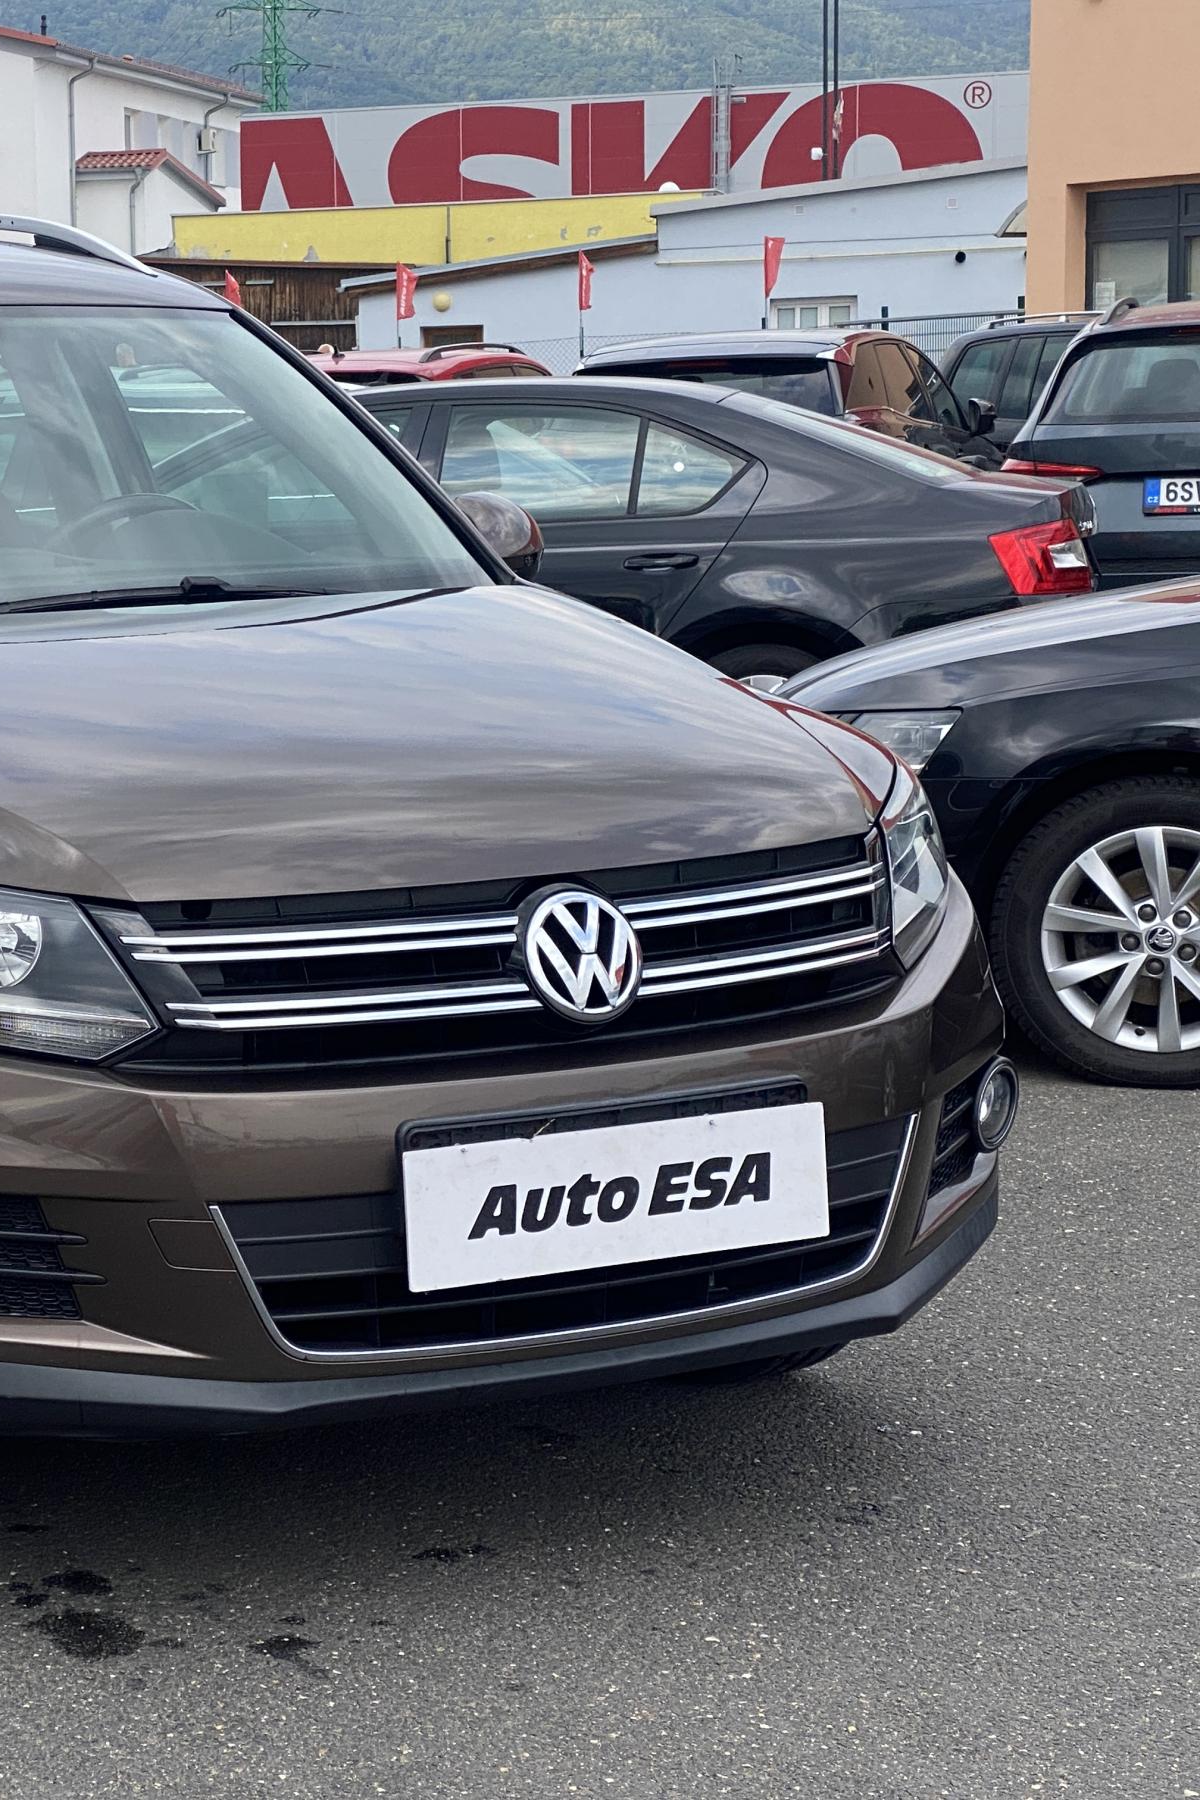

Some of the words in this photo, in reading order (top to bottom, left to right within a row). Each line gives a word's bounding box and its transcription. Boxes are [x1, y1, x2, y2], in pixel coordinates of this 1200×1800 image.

[1165, 480, 1200, 503] 6S
[467, 1173, 640, 1240] Auto
[647, 1151, 771, 1216] ESA
